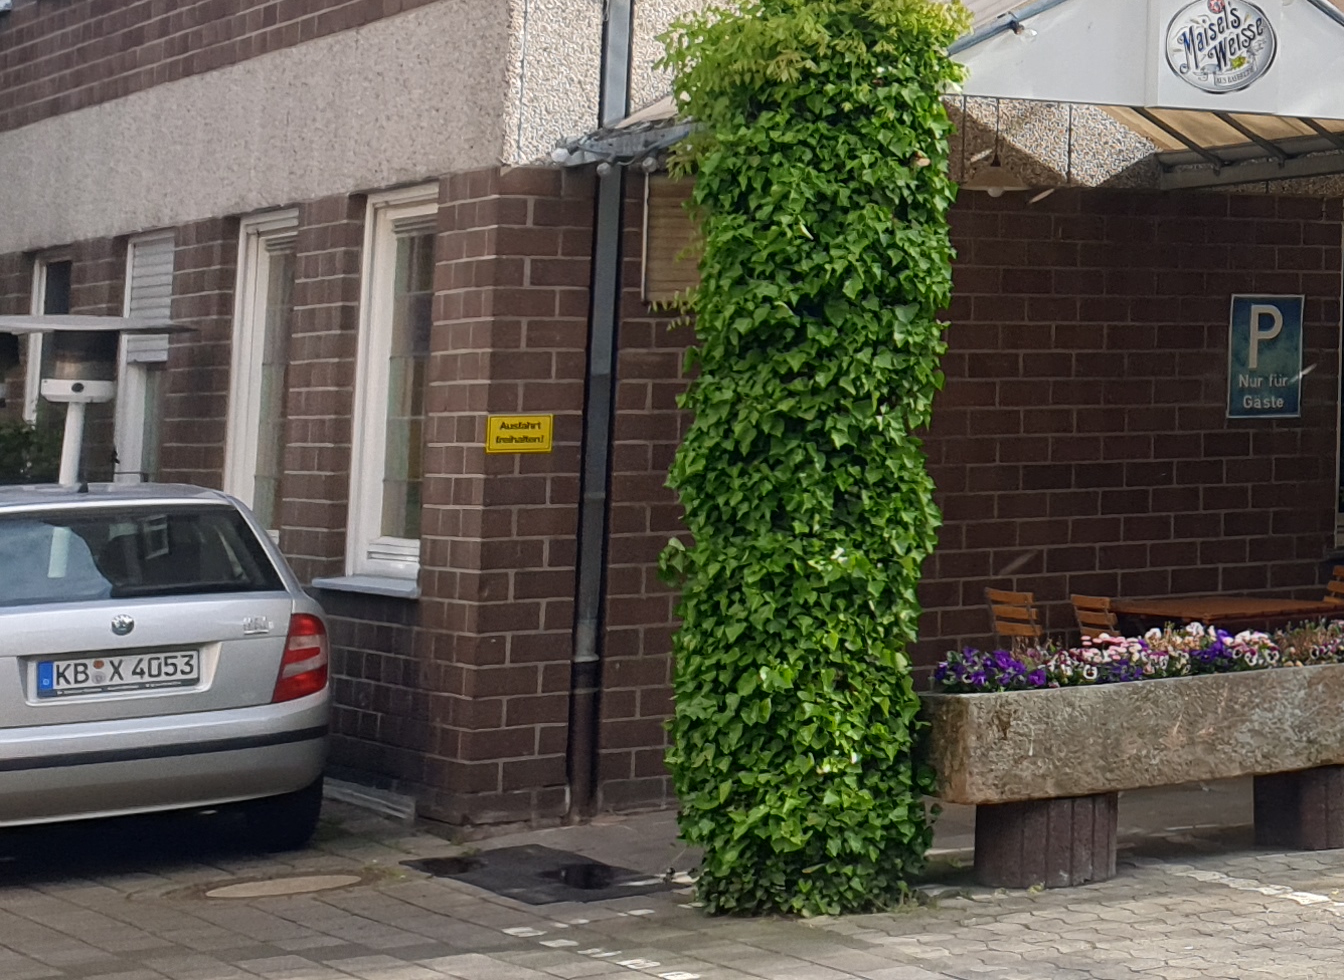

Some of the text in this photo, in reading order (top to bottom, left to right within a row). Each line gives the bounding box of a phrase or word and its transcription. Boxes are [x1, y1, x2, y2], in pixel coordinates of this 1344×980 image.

[1177, 1, 1241, 74] Maisel's
[1207, 18, 1264, 72] Weisse
[1248, 304, 1284, 369] P
[1239, 374, 1288, 388] Nur für
[1243, 395, 1285, 409] Gäste
[500, 421, 541, 430] Ausfahrt
[495, 435, 545, 444] freihalten!
[56, 654, 194, 686] KB X 4053
